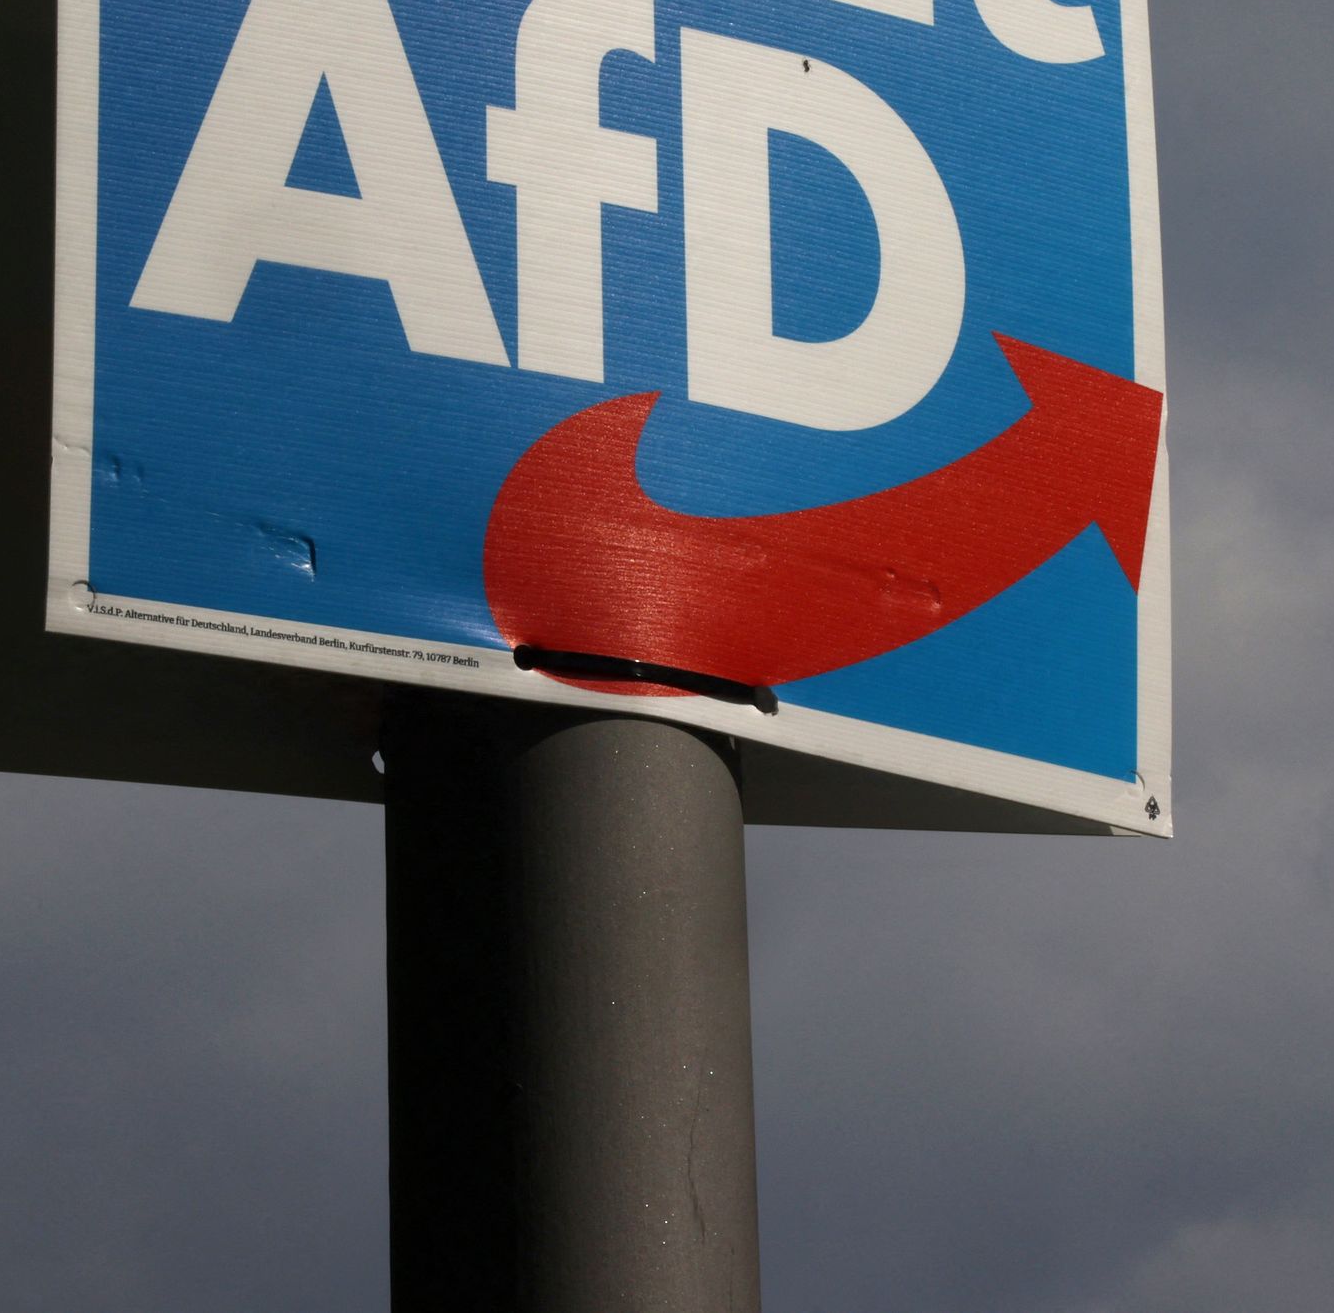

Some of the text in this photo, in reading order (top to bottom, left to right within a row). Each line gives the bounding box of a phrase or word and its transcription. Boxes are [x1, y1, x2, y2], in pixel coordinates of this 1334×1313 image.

[124, 609, 175, 625] Alternative
[175, 615, 190, 627] für
[191, 619, 249, 636] Deutschland,
[250, 627, 317, 645] Landesverband
[319, 637, 348, 651] Berlin,
[349, 641, 411, 659] Kurfürstenstr.
[412, 650, 425, 661] 79,
[426, 653, 452, 664] 10787
[453, 656, 479, 668] Berlin
